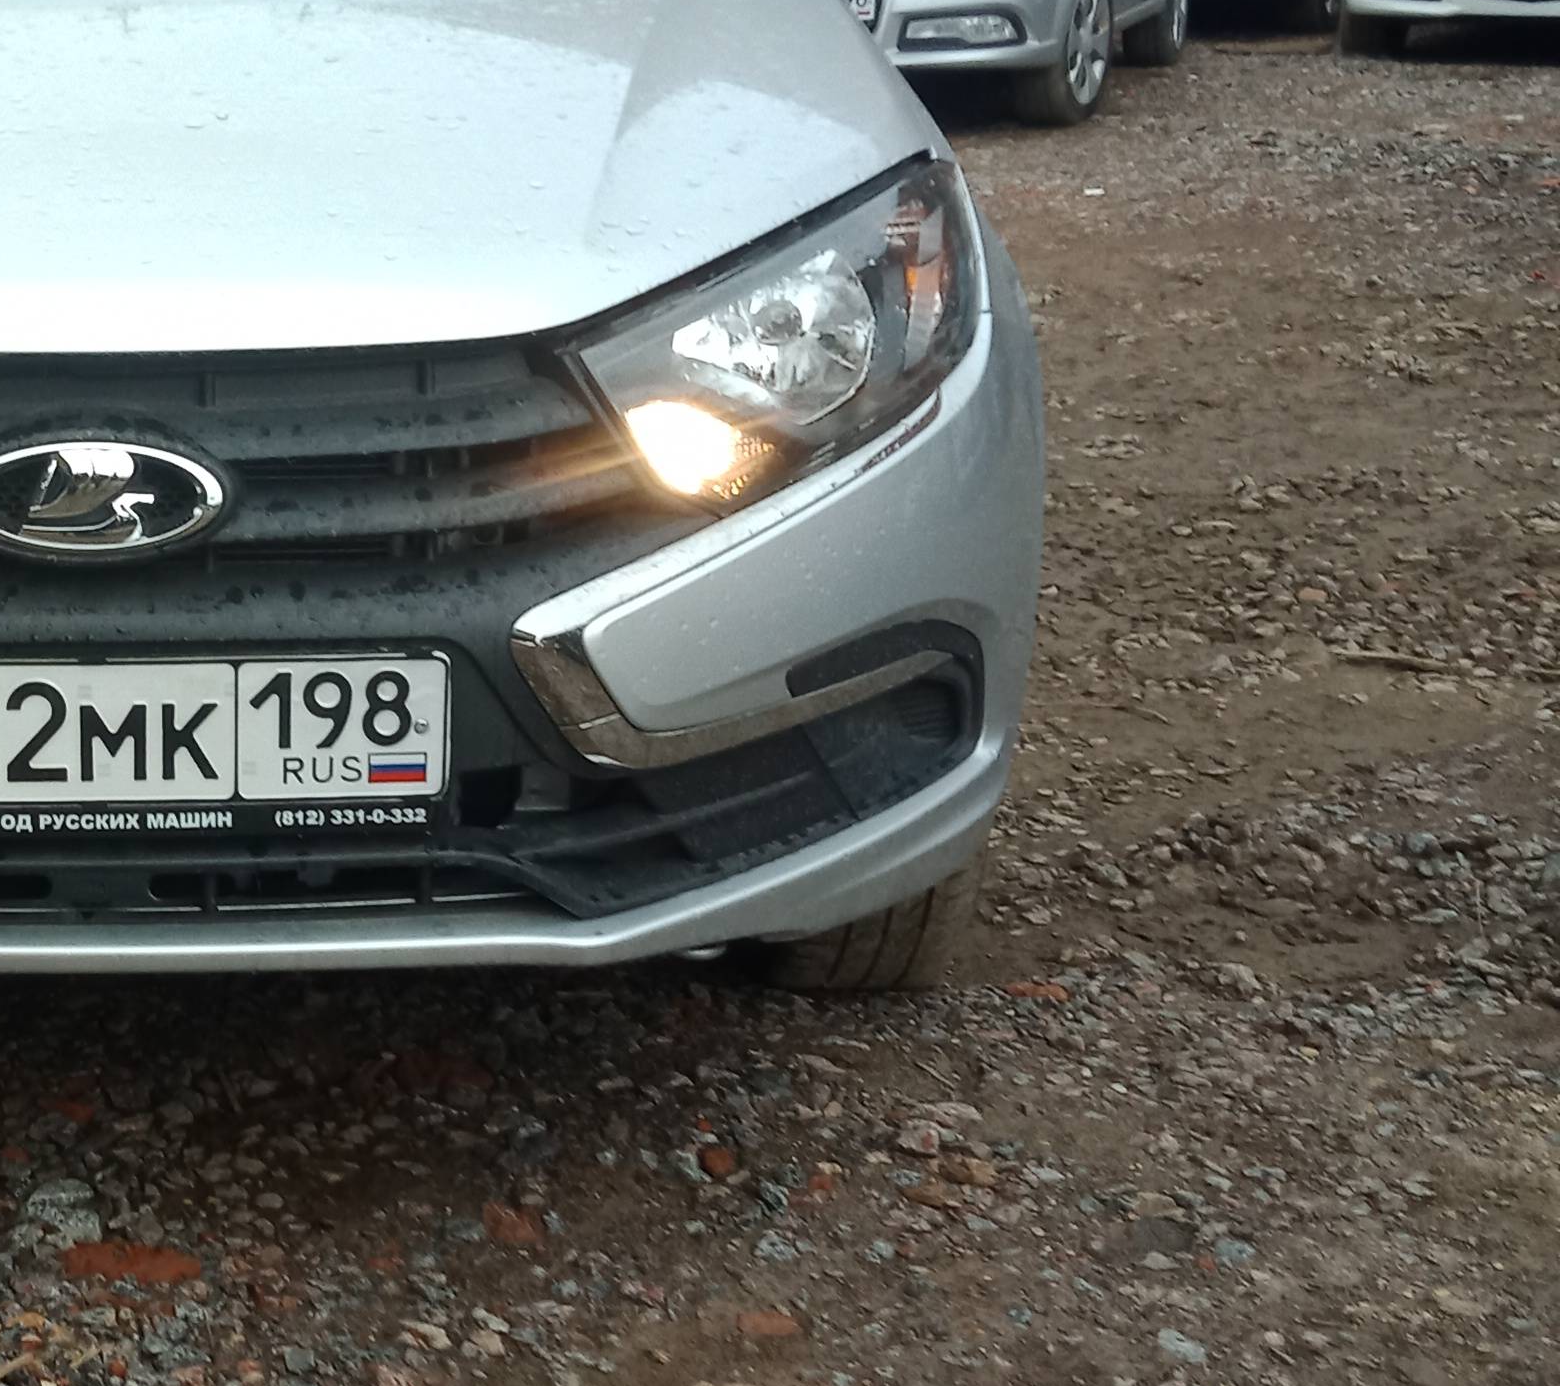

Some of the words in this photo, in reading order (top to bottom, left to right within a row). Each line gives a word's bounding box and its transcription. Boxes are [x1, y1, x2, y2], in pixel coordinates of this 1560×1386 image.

[249, 670, 412, 750] 198
[283, 755, 362, 785] RUS
[40, 812, 140, 831] РУССКИХ
[146, 810, 234, 830] МАШИН
[274, 809, 326, 828] (812)
[330, 807, 428, 825] 331-0-332
